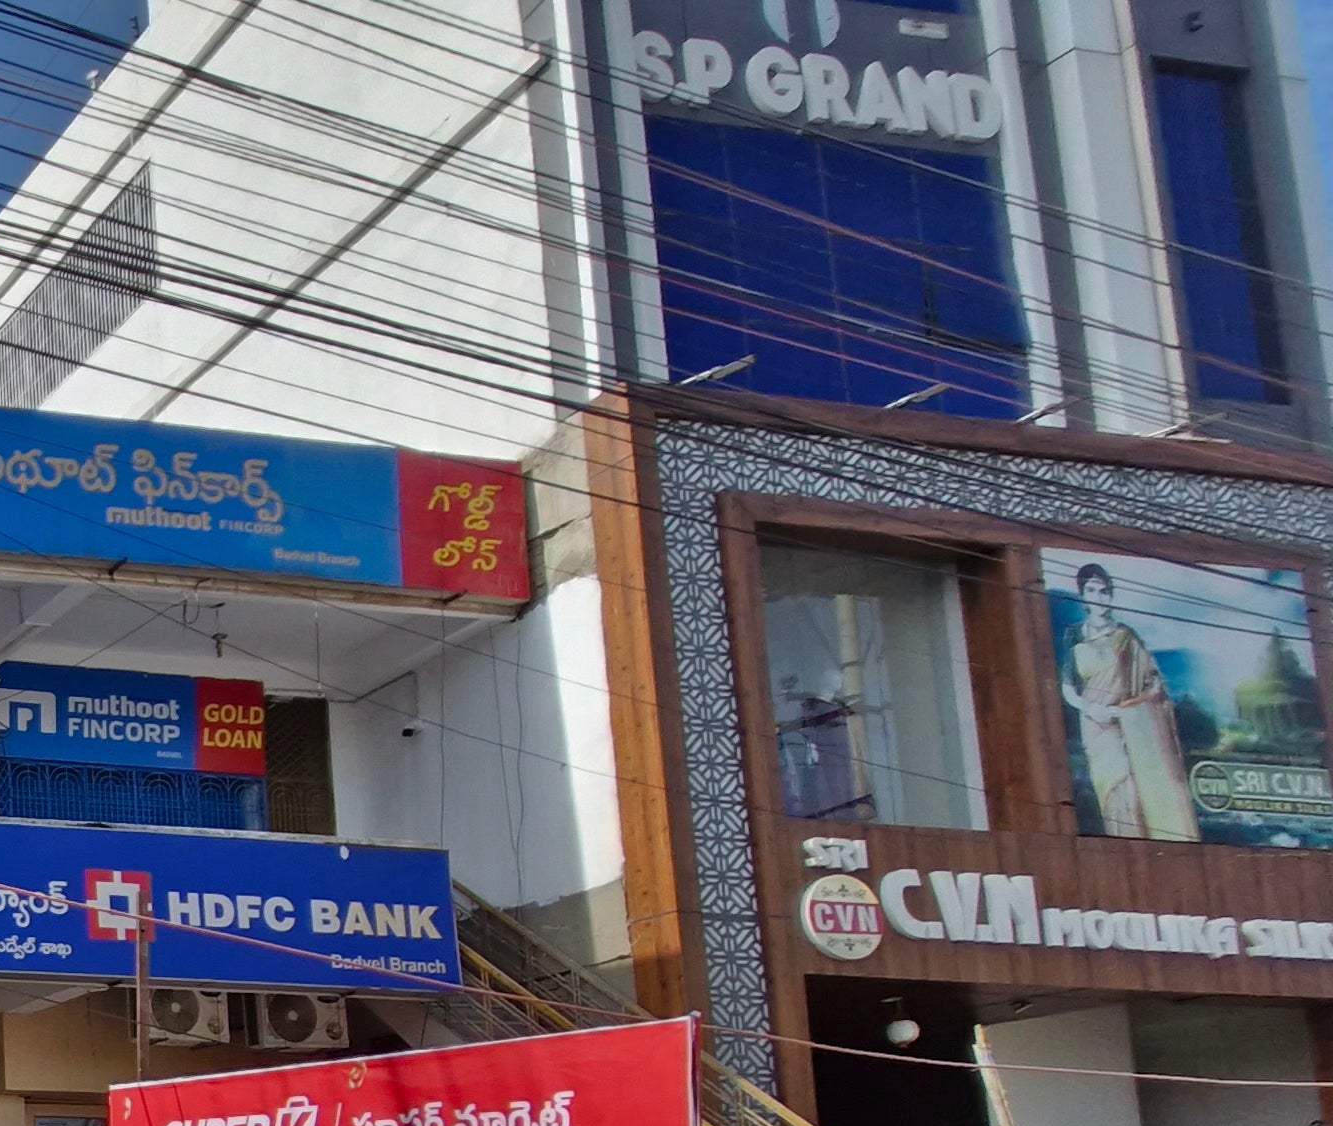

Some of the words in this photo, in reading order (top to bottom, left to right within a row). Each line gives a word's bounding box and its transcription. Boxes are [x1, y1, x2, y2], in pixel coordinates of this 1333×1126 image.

[745, 46, 1003, 144] GRAND
[106, 507, 212, 531] muthoot
[218, 518, 284, 535] FINCORP
[427, 482, 503, 530] గోల్డ్
[433, 536, 503, 571] లోన్
[67, 694, 181, 721] muthoot
[203, 703, 265, 725] GOLD
[68, 717, 181, 745] FINCORP
[202, 727, 263, 749] LOAN
[803, 837, 869, 872] SRI
[167, 891, 296, 932] HDFC
[310, 899, 443, 939] BANK
[813, 902, 880, 933] CVN
[1041, 907, 1240, 960] MOULIKA
[389, 956, 447, 974] Branch
